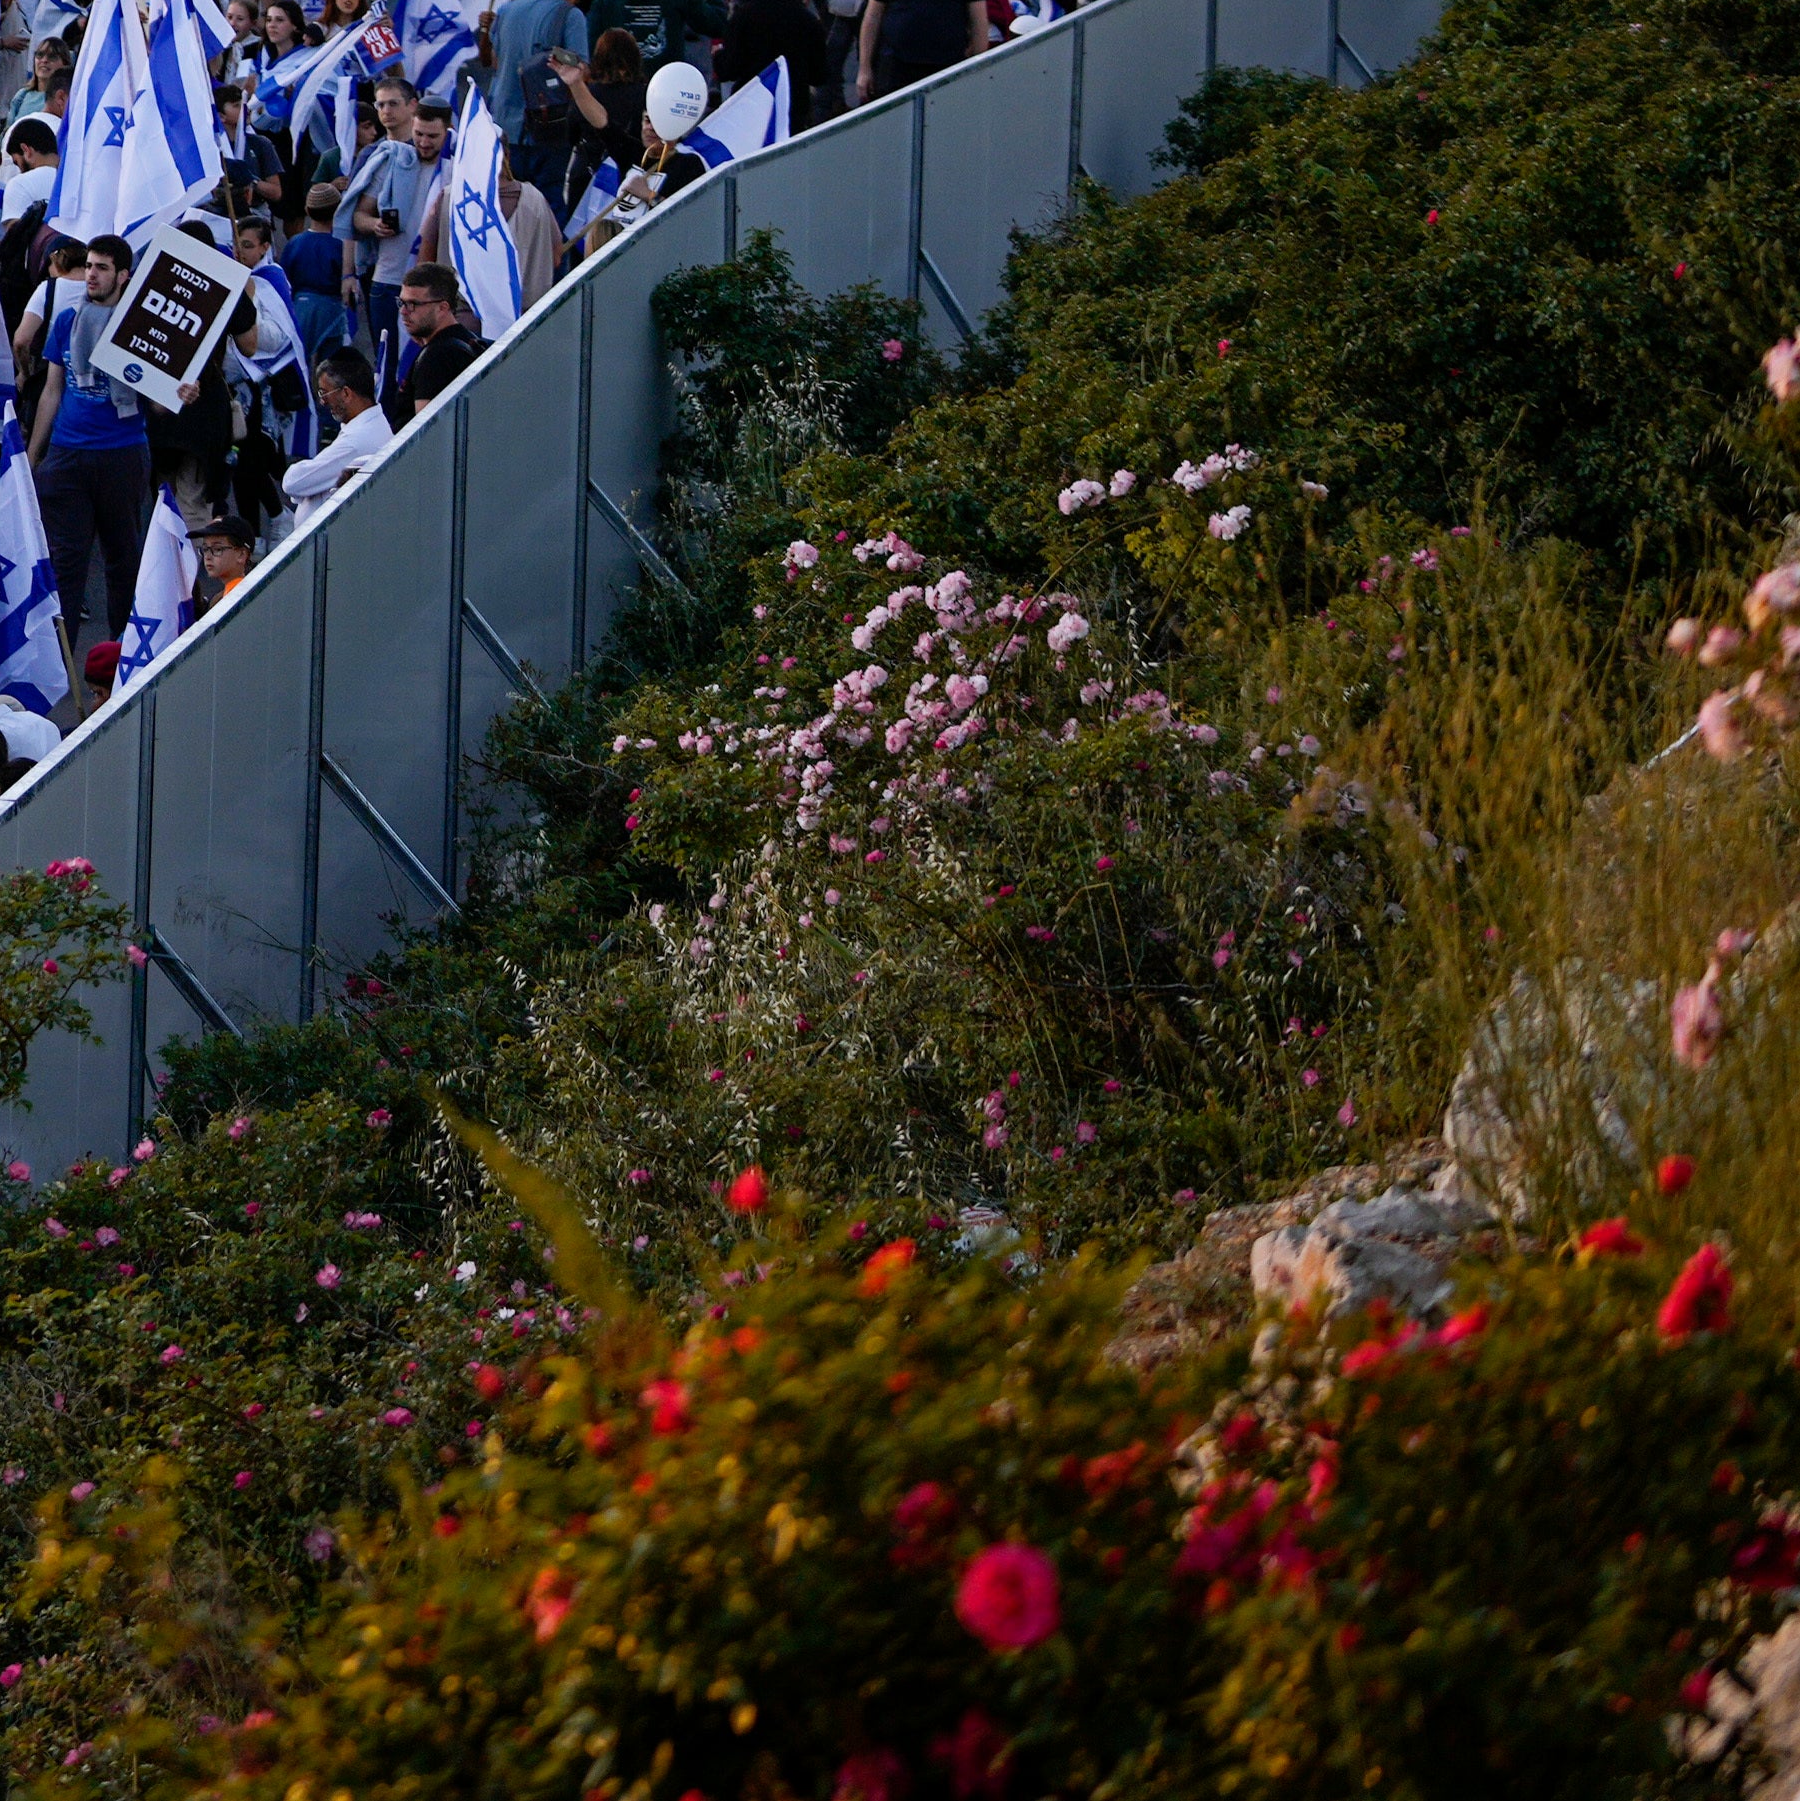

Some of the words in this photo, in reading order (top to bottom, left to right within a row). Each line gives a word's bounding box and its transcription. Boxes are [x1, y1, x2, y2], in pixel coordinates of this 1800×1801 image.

[170, 263, 211, 292] הכנסת
[172, 282, 193, 300] היא
[140, 288, 203, 338] העם
[129, 334, 171, 365] הריבון
[148, 326, 169, 344] הוא
